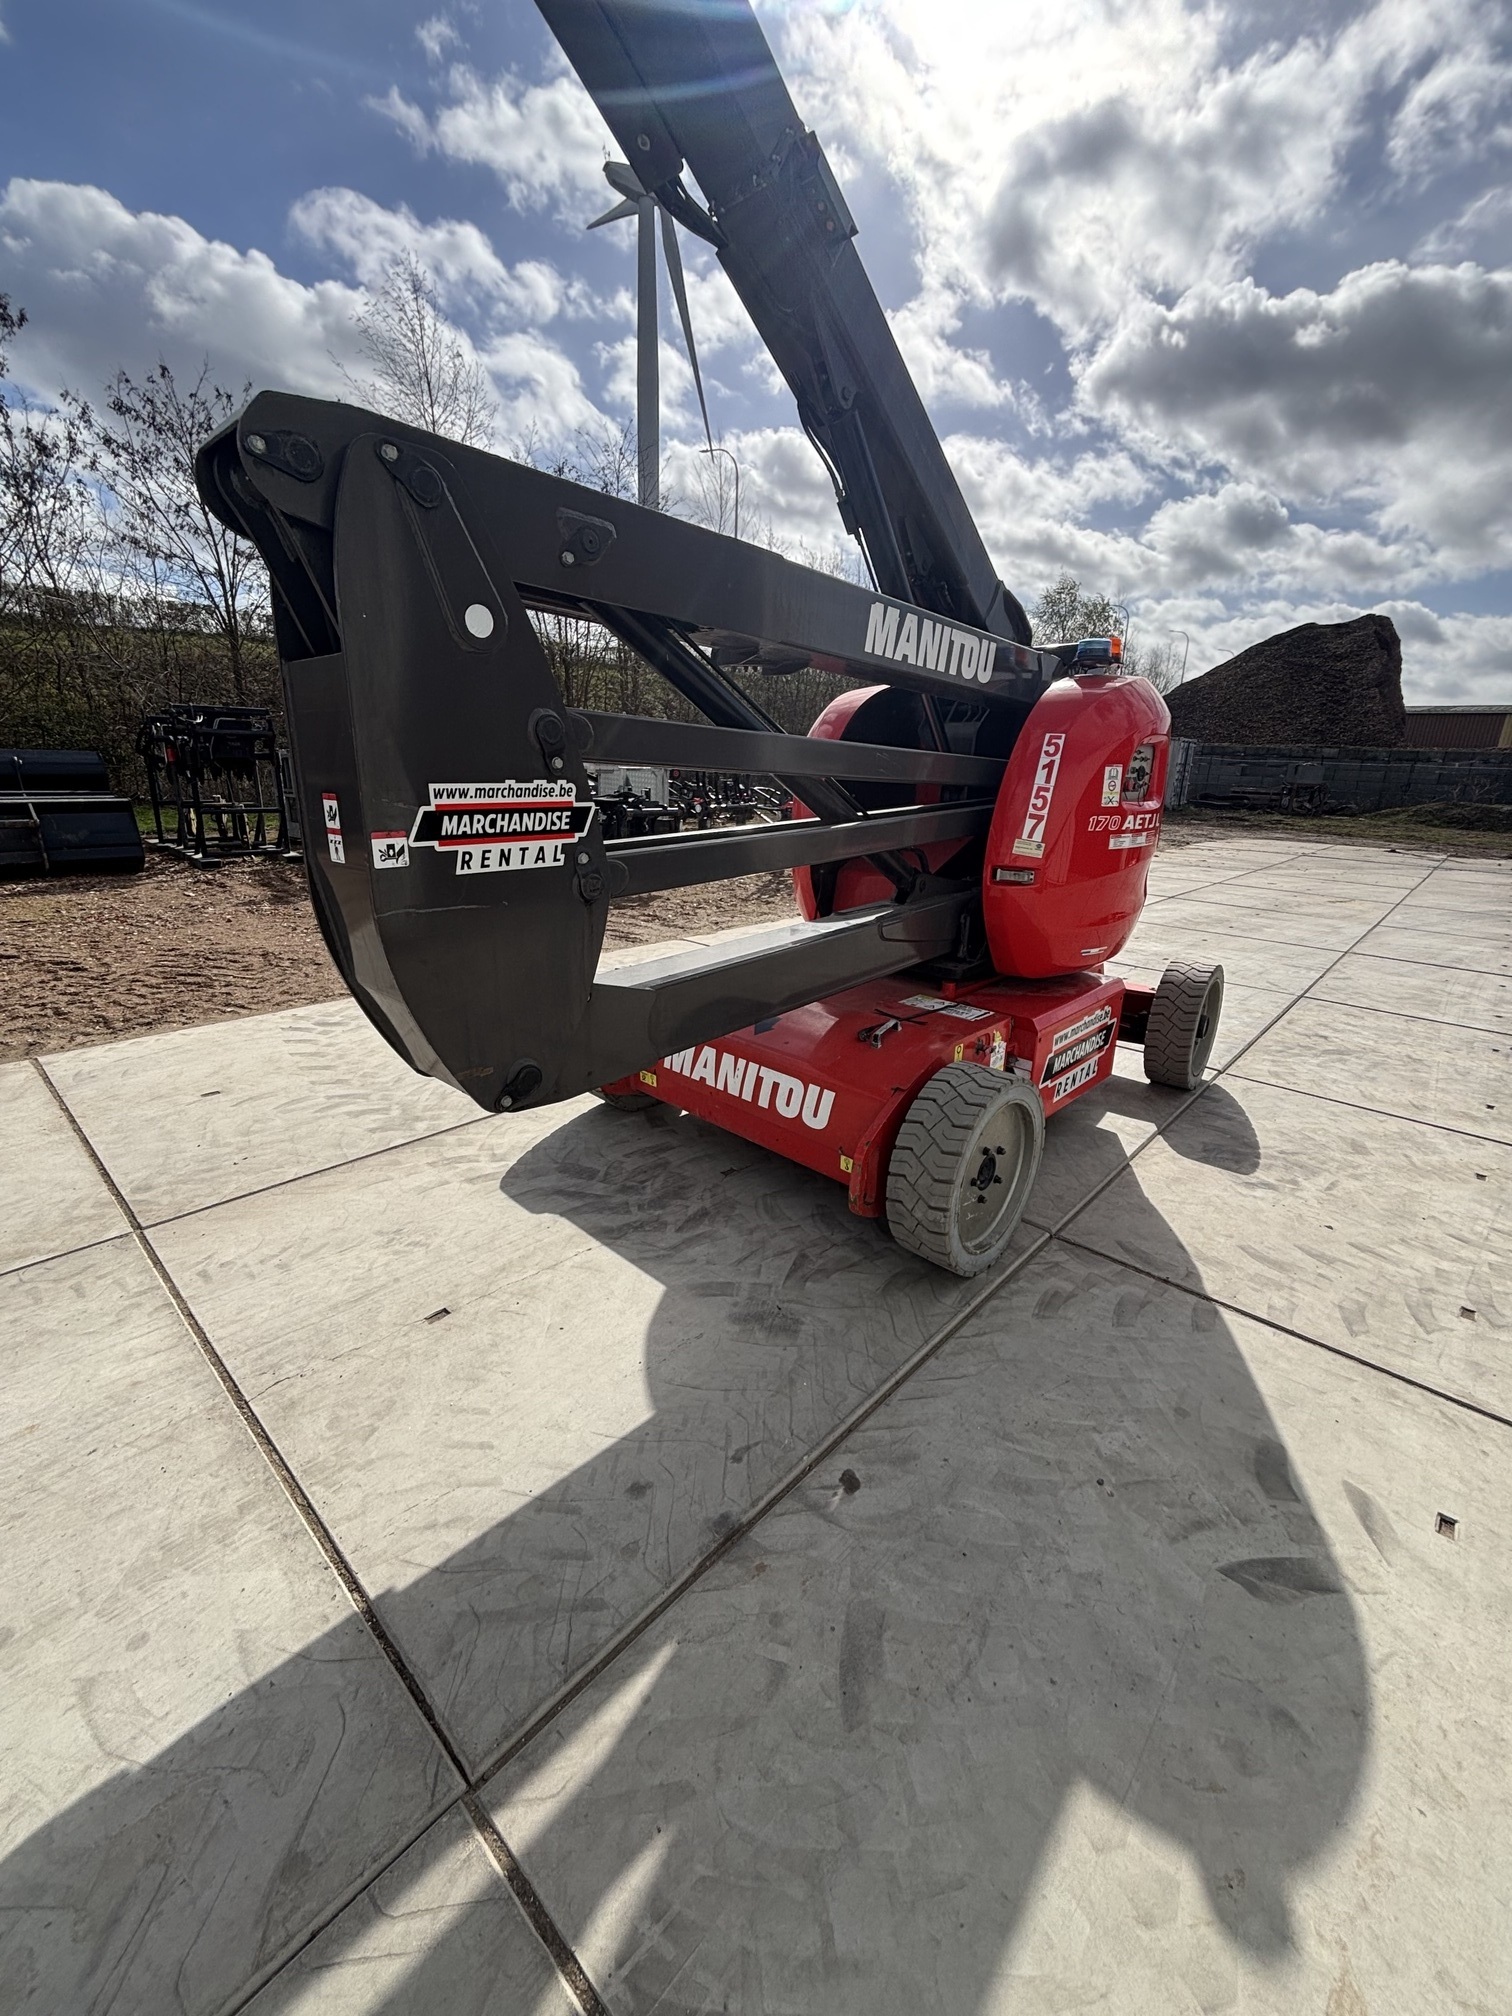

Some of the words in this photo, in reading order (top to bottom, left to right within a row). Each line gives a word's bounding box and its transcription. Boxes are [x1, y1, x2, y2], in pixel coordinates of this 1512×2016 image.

[864, 601, 997, 684] MANITOU
[433, 783, 573, 799] www.marchandise.be
[1026, 735, 1063, 839] 5157
[441, 812, 571, 836] MARCHANDISE
[1087, 815, 1121, 831] 170
[460, 845, 561, 870] RENTAL
[1052, 1030, 1107, 1075] MARCHANDISE
[663, 1045, 836, 1130] MANITOU
[1056, 1060, 1097, 1097] RENTAL
